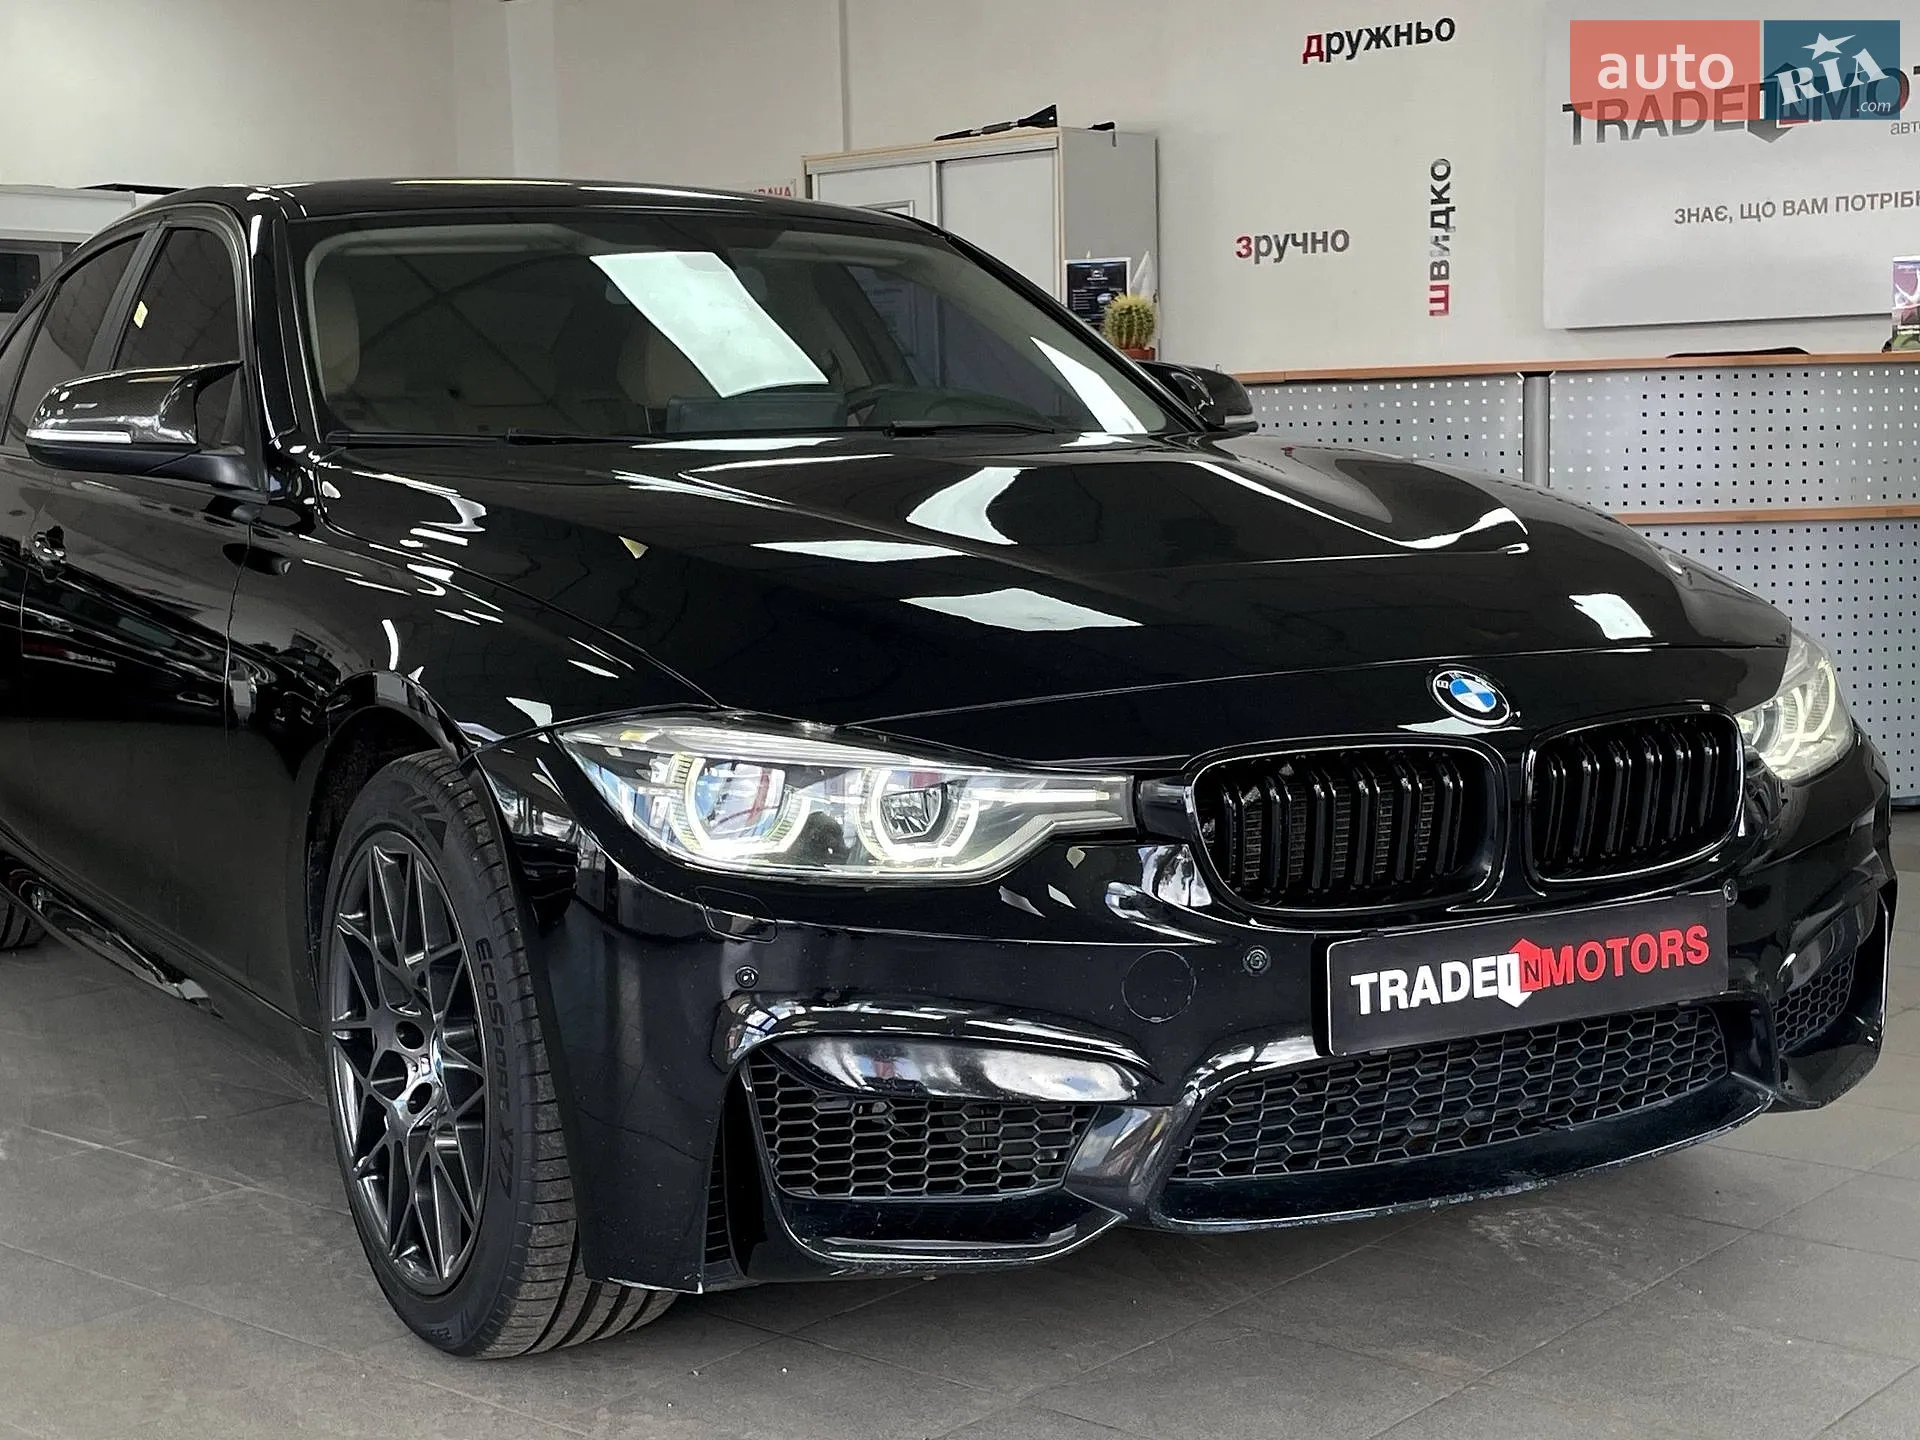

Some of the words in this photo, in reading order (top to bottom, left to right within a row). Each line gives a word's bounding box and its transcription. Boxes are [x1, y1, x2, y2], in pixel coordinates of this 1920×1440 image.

[1302, 17, 1456, 64] дружньо
[1890, 121, 1920, 136] авт
[1674, 205, 1733, 224] ЗНАЄ,
[1739, 201, 1777, 222] ЩО
[1782, 197, 1828, 217] ВАМ
[1235, 229, 1350, 265] зручно
[1428, 158, 1457, 317] швидко
